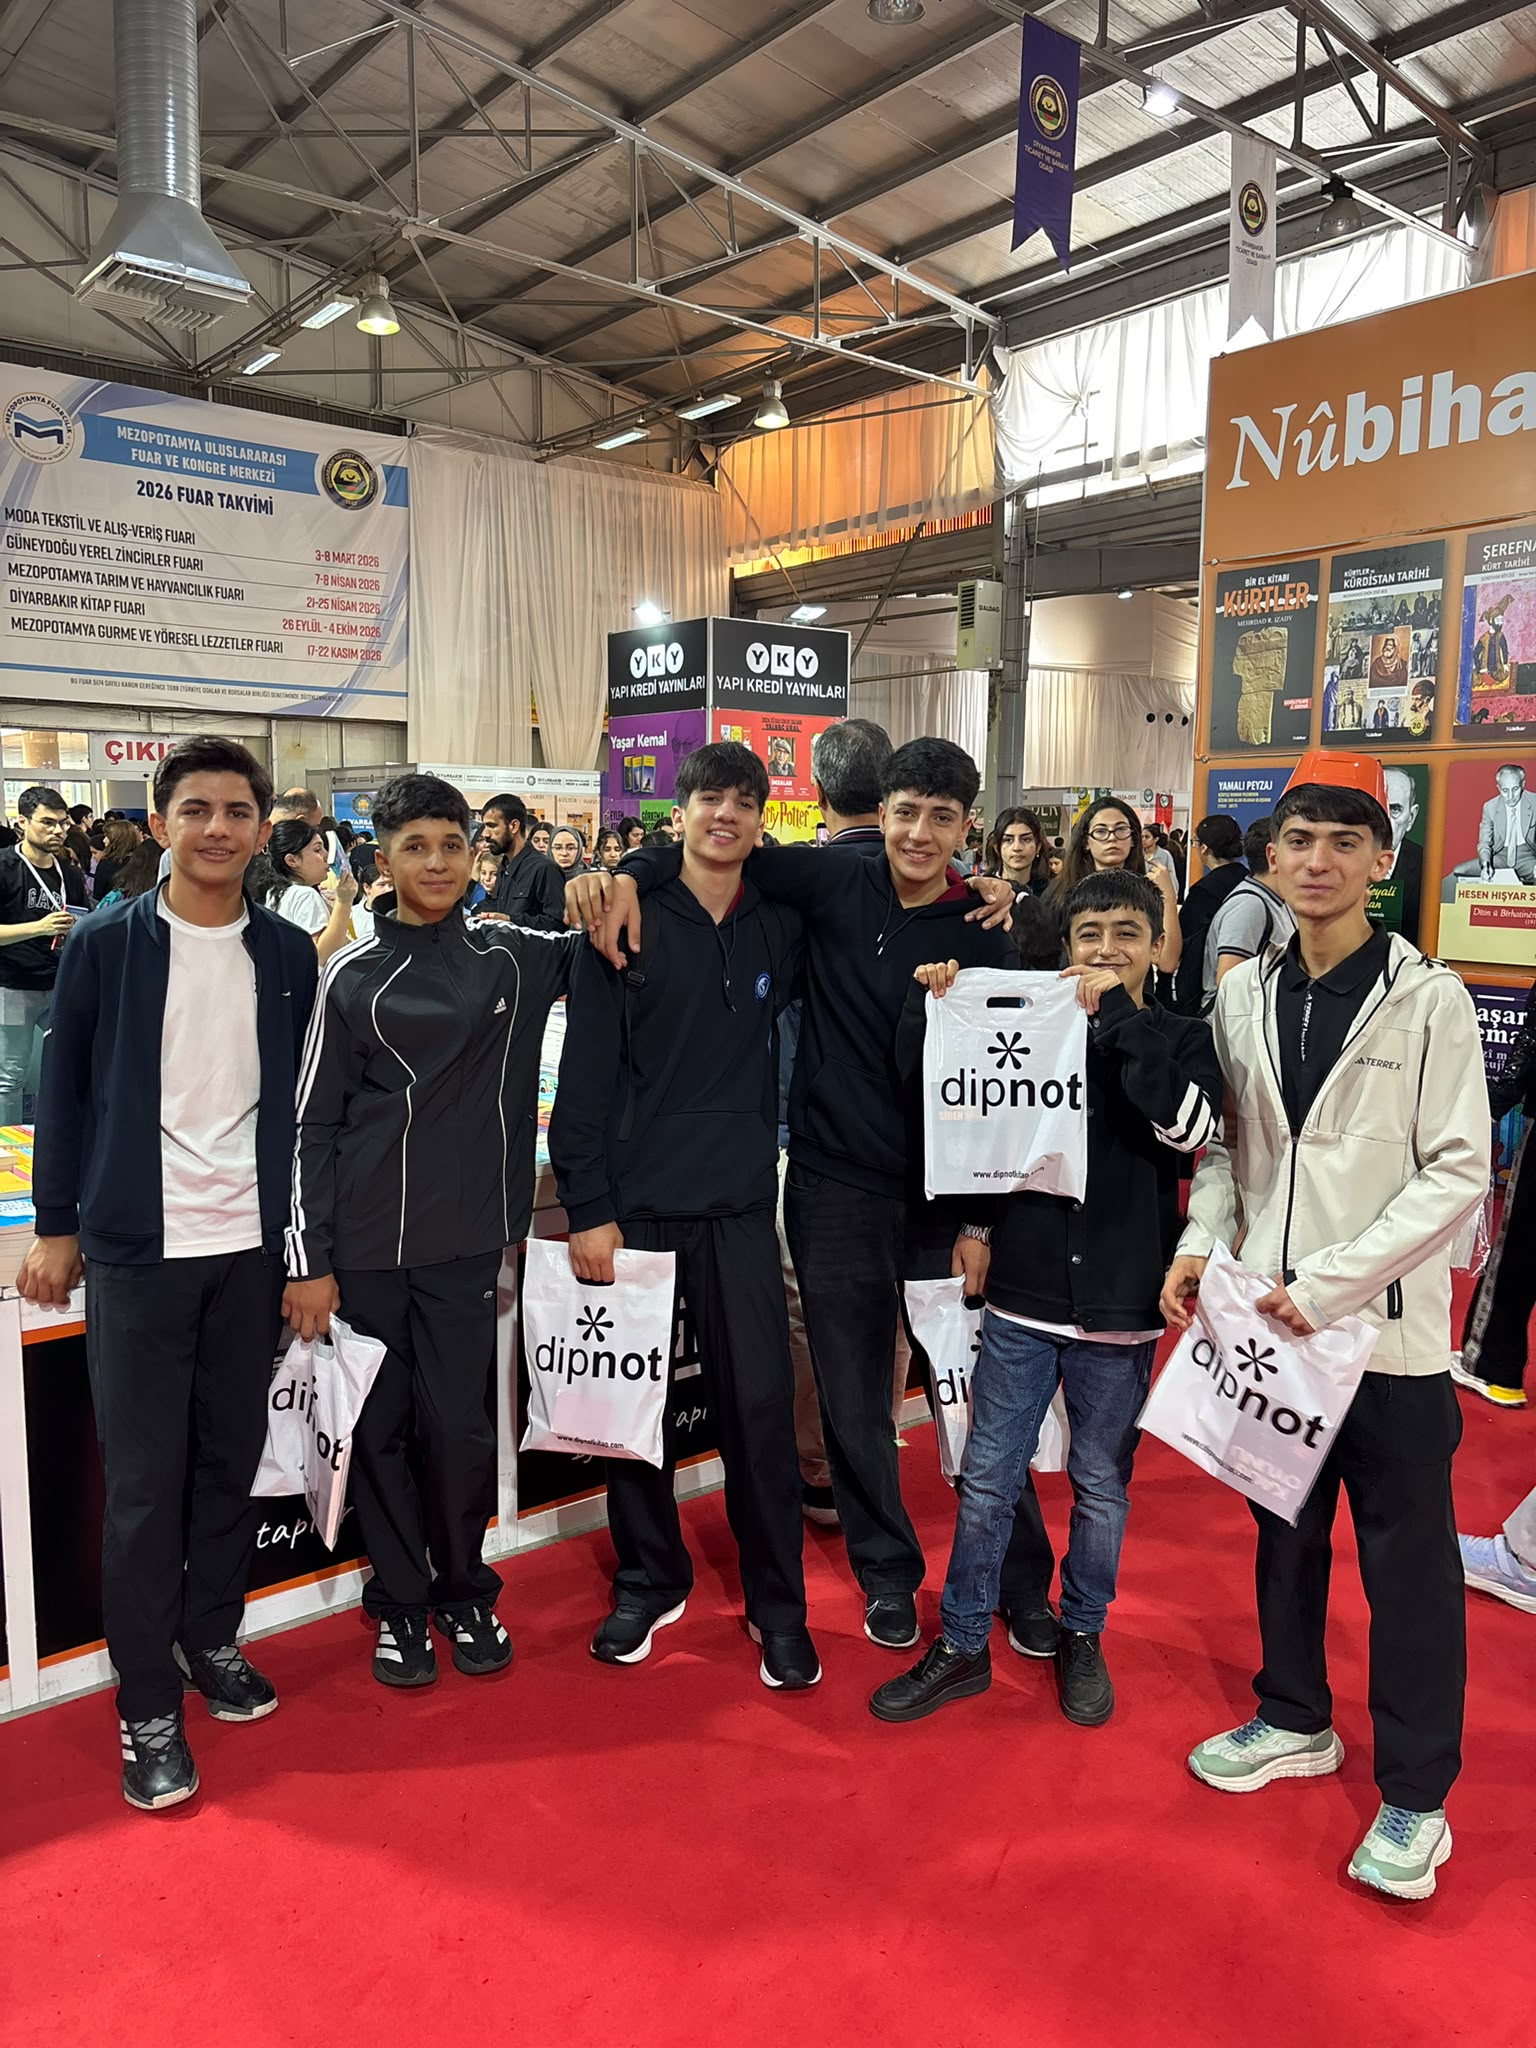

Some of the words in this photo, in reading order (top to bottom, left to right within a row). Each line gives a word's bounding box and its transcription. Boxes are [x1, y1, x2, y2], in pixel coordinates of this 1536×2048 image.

[118, 426, 202, 452] MEZOPOTAMYA
[205, 441, 287, 467] ULUSLARARASI
[131, 448, 162, 465] FUAR
[165, 454, 179, 468] VE
[183, 457, 226, 476] KONGRE
[230, 464, 276, 484] MERKEZİ
[136, 480, 174, 500] 2026
[177, 486, 214, 507] FUAR
[218, 492, 274, 516] TAKVİMİ
[5, 507, 40, 525] MODA
[42, 512, 86, 530] TEKSTİL
[88, 518, 102, 532] VE
[104, 521, 162, 543] ALIŞ-VERİŞ
[165, 528, 196, 545] FUARI
[6, 533, 77, 556] GÜNEYDOĞU
[79, 543, 114, 560] YEREL
[116, 546, 170, 568] ZİNCİRLER
[173, 556, 204, 572] FUARI
[315, 549, 331, 562] 3-8
[332, 551, 356, 565] MART
[358, 554, 380, 568] 2026
[1481, 562, 1502, 572] KÜRT
[1504, 556, 1530, 568] TARİHİ
[8, 562, 94, 584] MEZOPOTAMYA
[95, 572, 129, 588] TARIM
[131, 576, 144, 590] VE
[147, 578, 214, 598] HAYVANCILIK
[216, 586, 244, 600] FUARI
[315, 573, 329, 586] 7-8
[331, 573, 357, 588] NİSAN
[358, 578, 380, 591] 2026
[1245, 576, 1257, 587] BİR
[1258, 577, 1266, 586] EL
[1268, 573, 1290, 584] KİTABI
[1343, 573, 1396, 589] KÜRDİSTAN
[1397, 565, 1430, 582] TARİHİ
[1344, 567, 1370, 578] KÜRTLER
[10, 587, 78, 609] DİYARBAKIR
[80, 594, 112, 612] KİTAP
[114, 600, 146, 616] FUARI
[306, 596, 330, 610] 21-25
[331, 597, 358, 612] NİSAN
[359, 602, 381, 614] 2026
[1223, 582, 1310, 618] KÜRTLER
[282, 618, 294, 630] 26
[296, 618, 322, 633] EYLÜL
[329, 622, 335, 634] 4
[336, 622, 358, 636] EKİM
[360, 626, 382, 638] 2026
[1237, 618, 1267, 627] MEHRDAD
[12, 616, 96, 638] MEZOPOTAMYA
[98, 624, 136, 641] GURME
[139, 628, 152, 642] VE
[154, 628, 200, 647] YÖRESEL
[202, 634, 254, 652] LEZZETLER
[255, 640, 284, 654] FUARI
[308, 645, 330, 658] 17-22
[331, 646, 358, 660] KASIM
[360, 649, 382, 662] 2026
[749, 647, 816, 674] YKY
[610, 684, 629, 700] YAPI
[630, 678, 657, 698] KREDİ
[658, 675, 706, 695] YAYINLARI
[716, 675, 744, 692] YAPI
[746, 678, 784, 694] KREDİ
[786, 682, 846, 699] YAYINLARI
[610, 736, 636, 752] Yaşar
[637, 730, 668, 748] Kemal
[1218, 781, 1245, 791] YAMALI
[1246, 780, 1273, 790] PEYZAJ
[763, 806, 780, 830] rry
[780, 801, 810, 833] Potter
[1458, 890, 1489, 900] HESEN
[1477, 1007, 1528, 1029] aşar
[1479, 1027, 1520, 1045] ema
[1366, 1057, 1403, 1071] TERREX
[941, 1068, 1083, 1116] dipnot
[535, 1336, 662, 1384] dipnot
